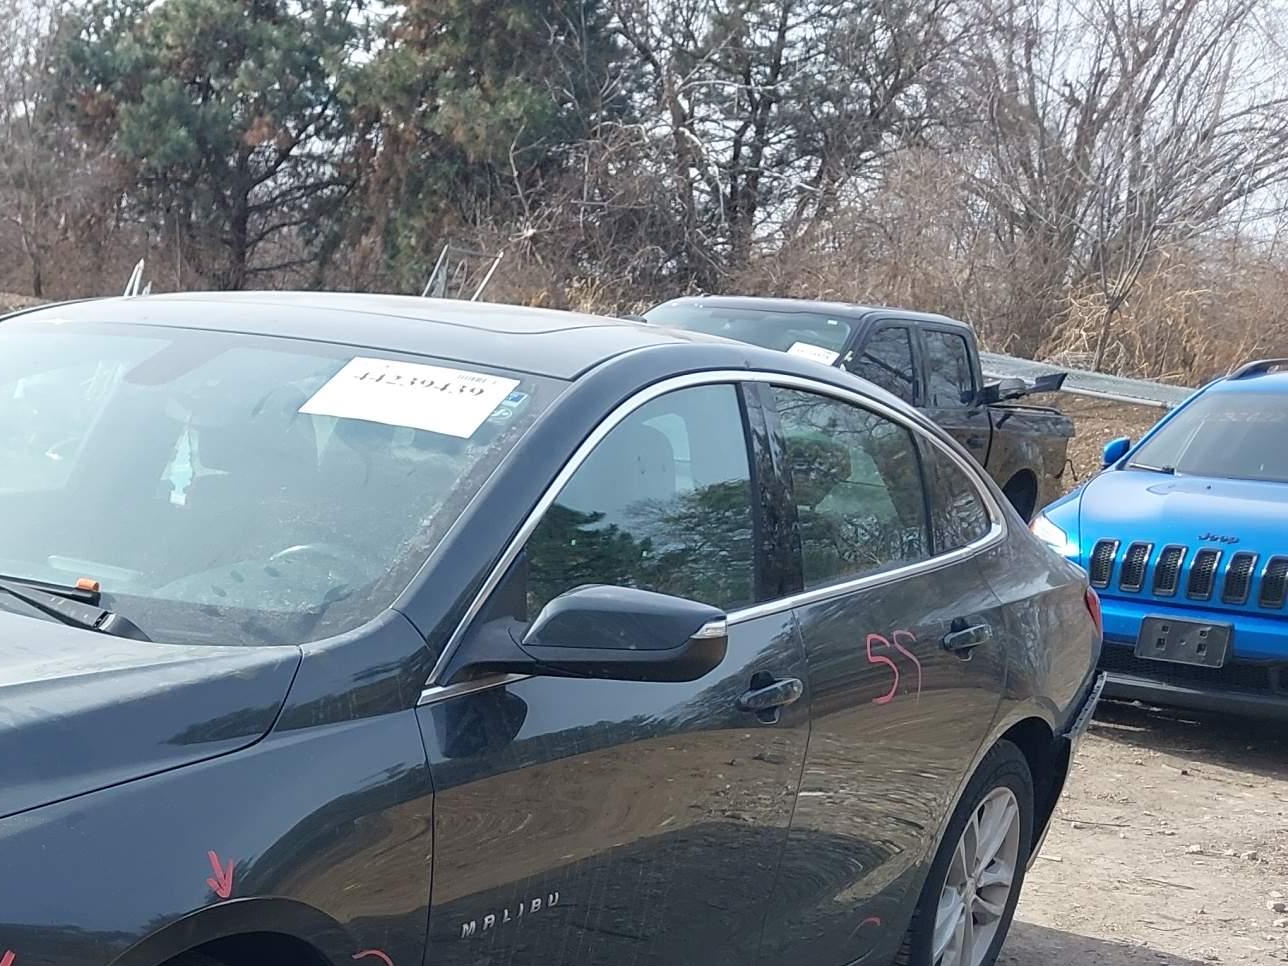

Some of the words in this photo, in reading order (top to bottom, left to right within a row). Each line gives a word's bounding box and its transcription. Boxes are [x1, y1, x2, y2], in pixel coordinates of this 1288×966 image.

[353, 371, 487, 399] 44239439
[1197, 532, 1241, 545] Jeep
[460, 891, 560, 939] MALIBU
